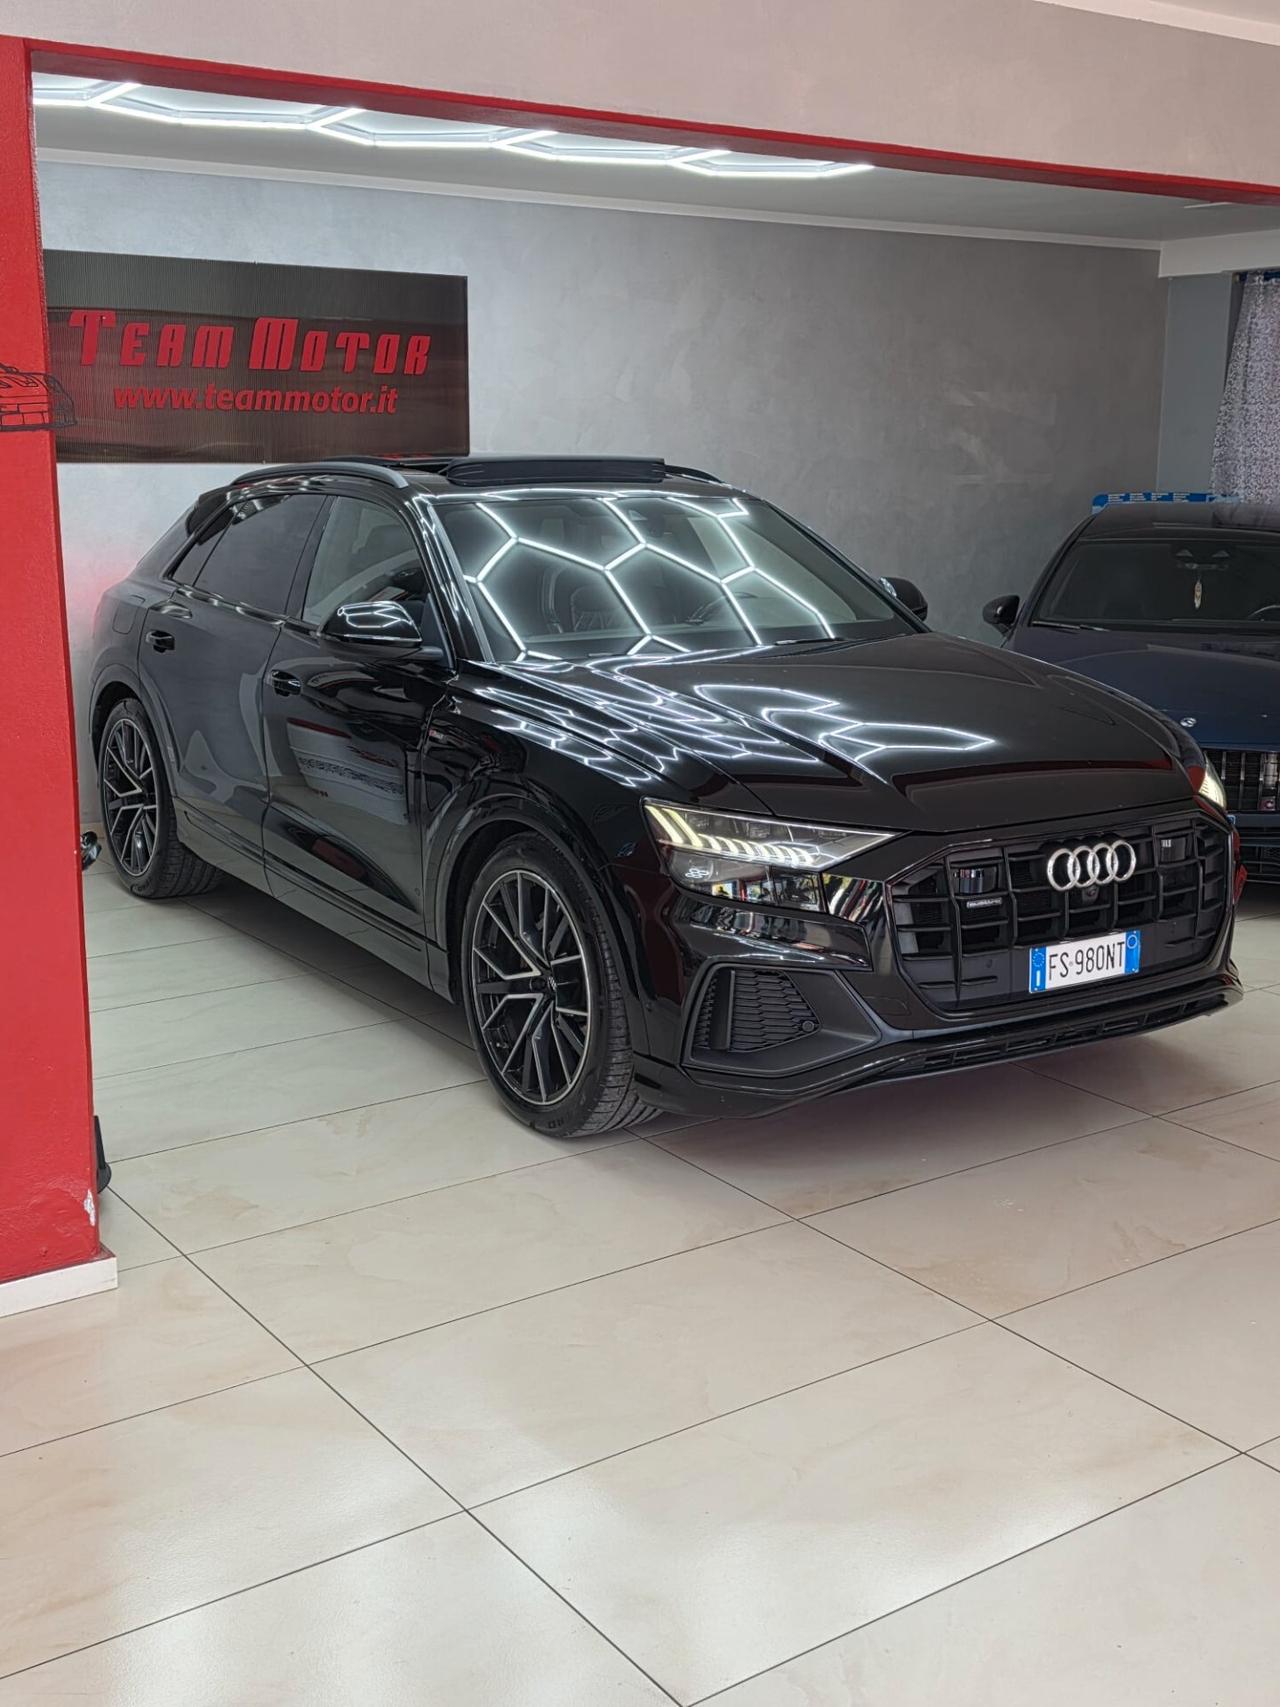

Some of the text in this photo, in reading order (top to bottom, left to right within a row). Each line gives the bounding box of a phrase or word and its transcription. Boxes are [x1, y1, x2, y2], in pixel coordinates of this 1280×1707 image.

[69, 309, 431, 375] TEAM MOTOR
[113, 384, 398, 414] www.teammotor.it
